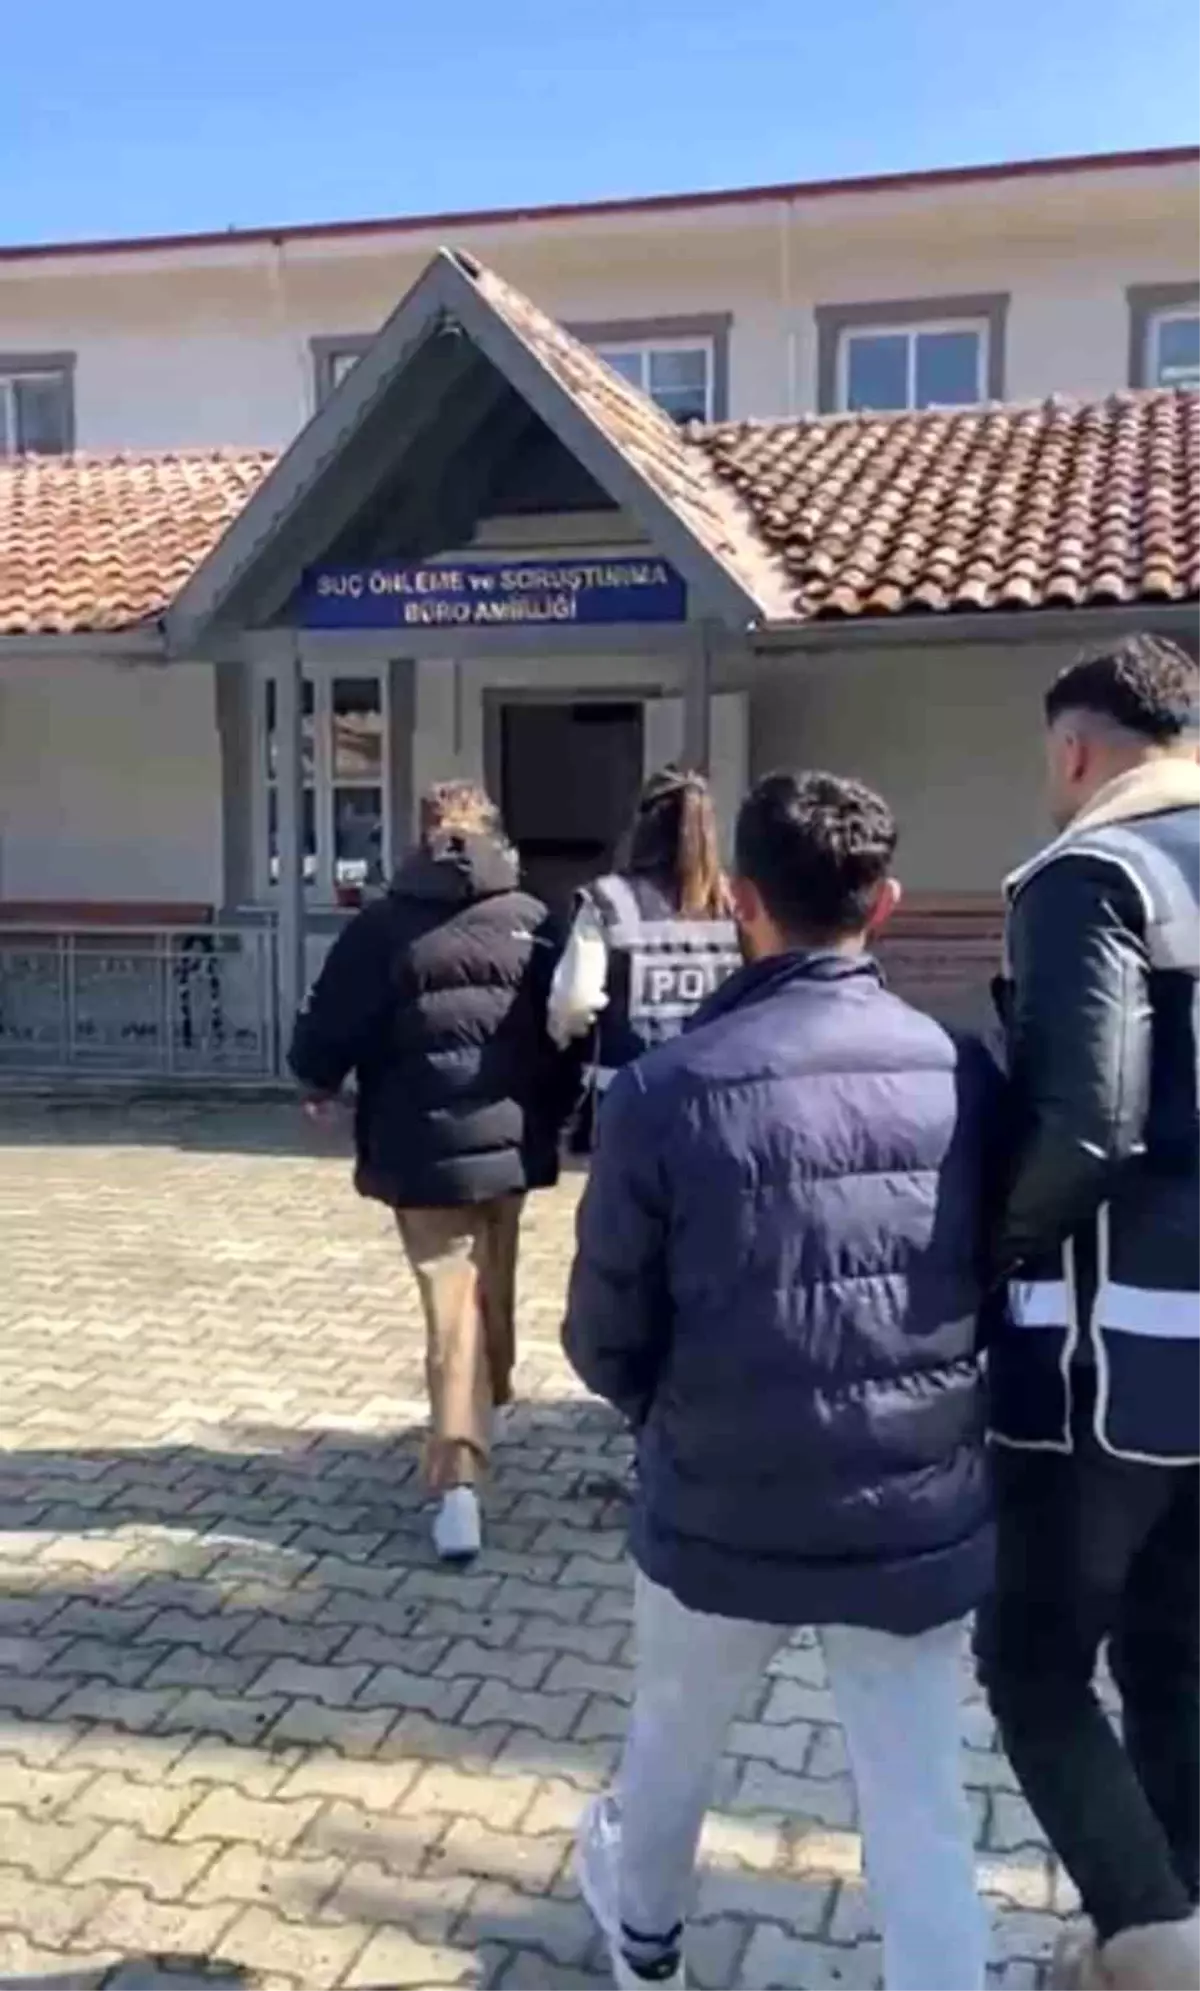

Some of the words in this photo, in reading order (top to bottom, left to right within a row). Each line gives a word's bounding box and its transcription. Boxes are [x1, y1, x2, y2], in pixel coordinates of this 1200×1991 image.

[317, 572, 363, 599] SUÇ
[368, 568, 465, 595] ÖNLEME
[468, 575, 494, 592] ve
[404, 600, 471, 624] BÜRO
